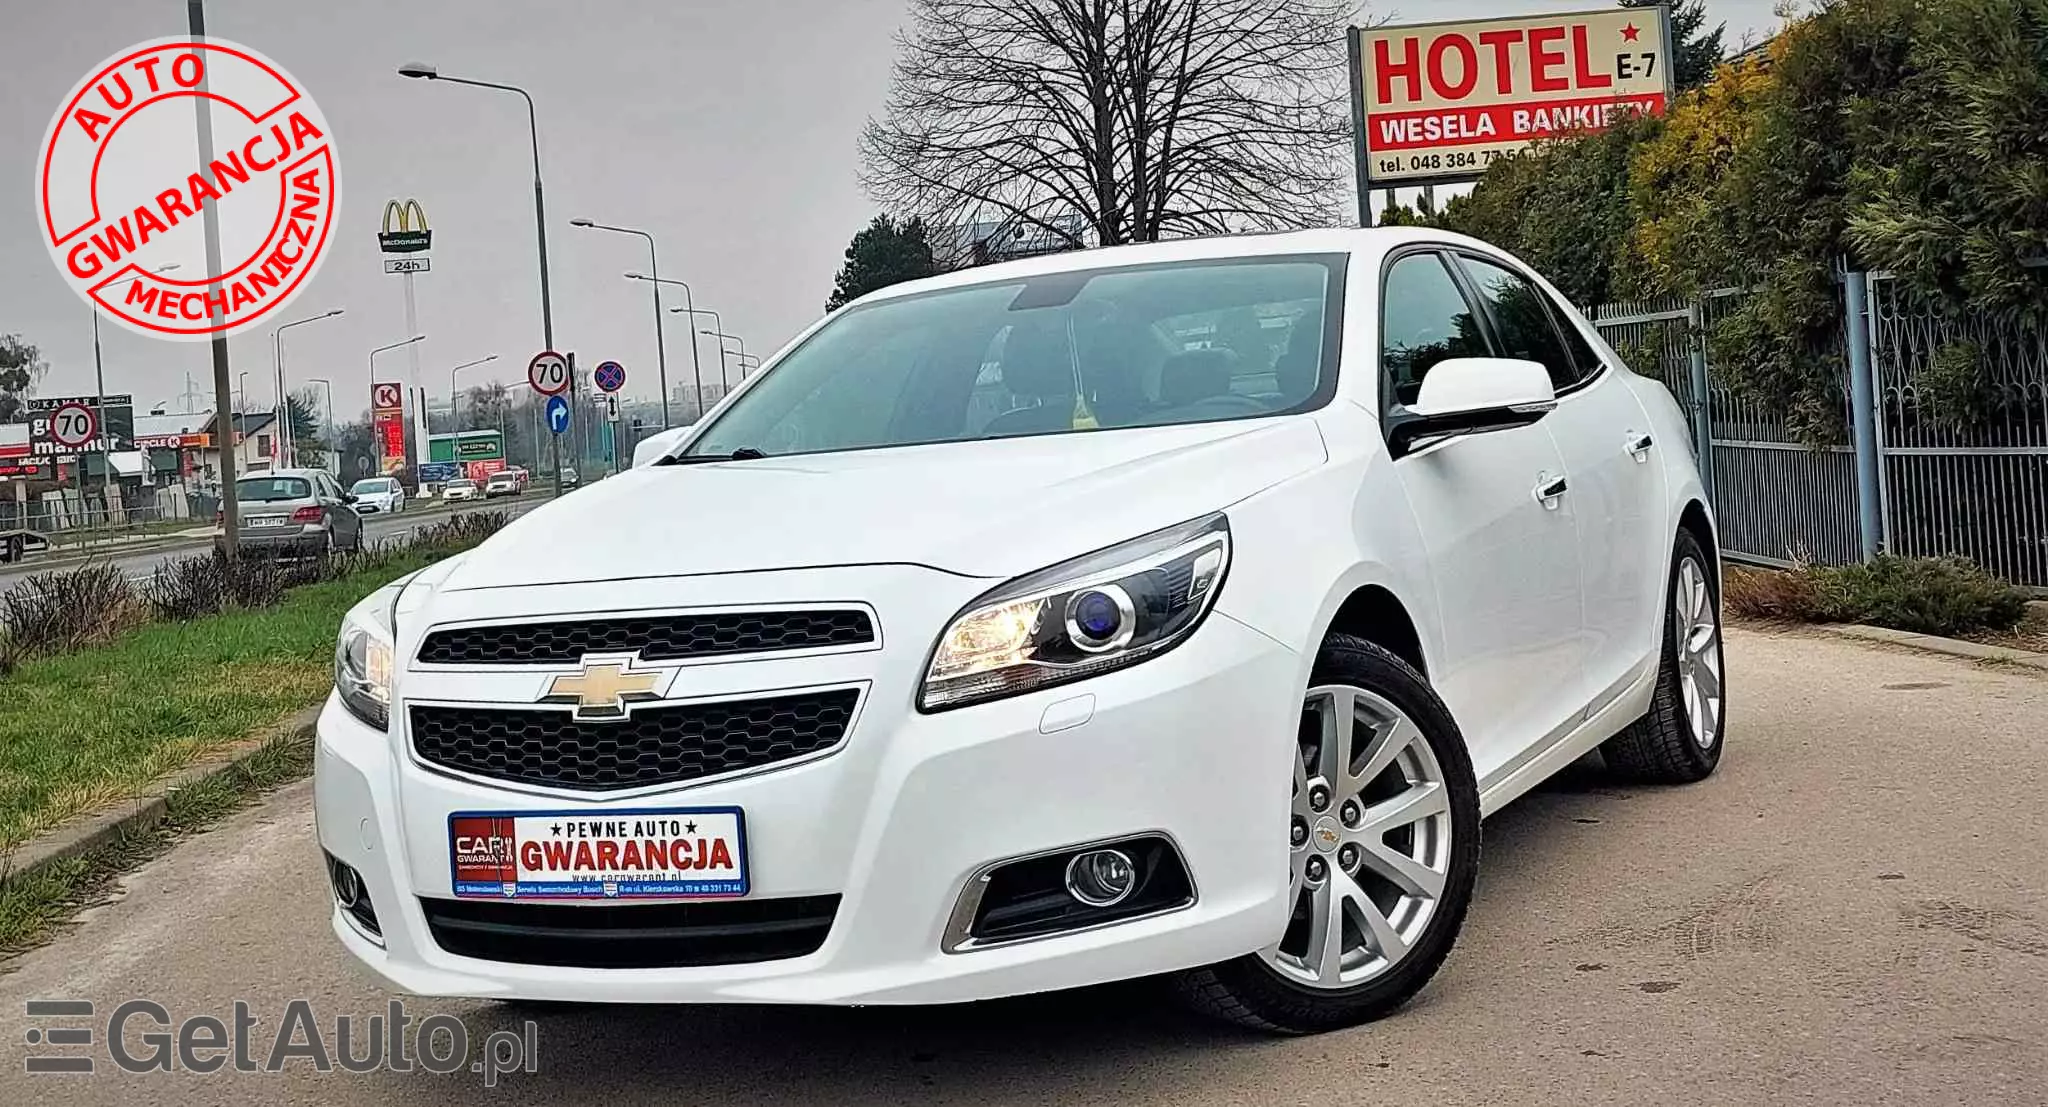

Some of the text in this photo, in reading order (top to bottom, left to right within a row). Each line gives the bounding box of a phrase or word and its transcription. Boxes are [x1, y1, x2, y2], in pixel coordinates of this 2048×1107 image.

[1374, 25, 1656, 104] HOTEL E-7
[1381, 113, 1496, 144] WESELA
[1380, 157, 1405, 172] tel.
[1411, 155, 1441, 170] 048
[1446, 152, 1476, 167] 384
[394, 261, 420, 270] 24h
[536, 363, 563, 384] 70
[379, 388, 397, 405] K
[59, 415, 89, 436] 70
[567, 820, 680, 838] PEWNE AUTO
[456, 837, 504, 854] CAR
[521, 838, 733, 872] GWARANCJA
